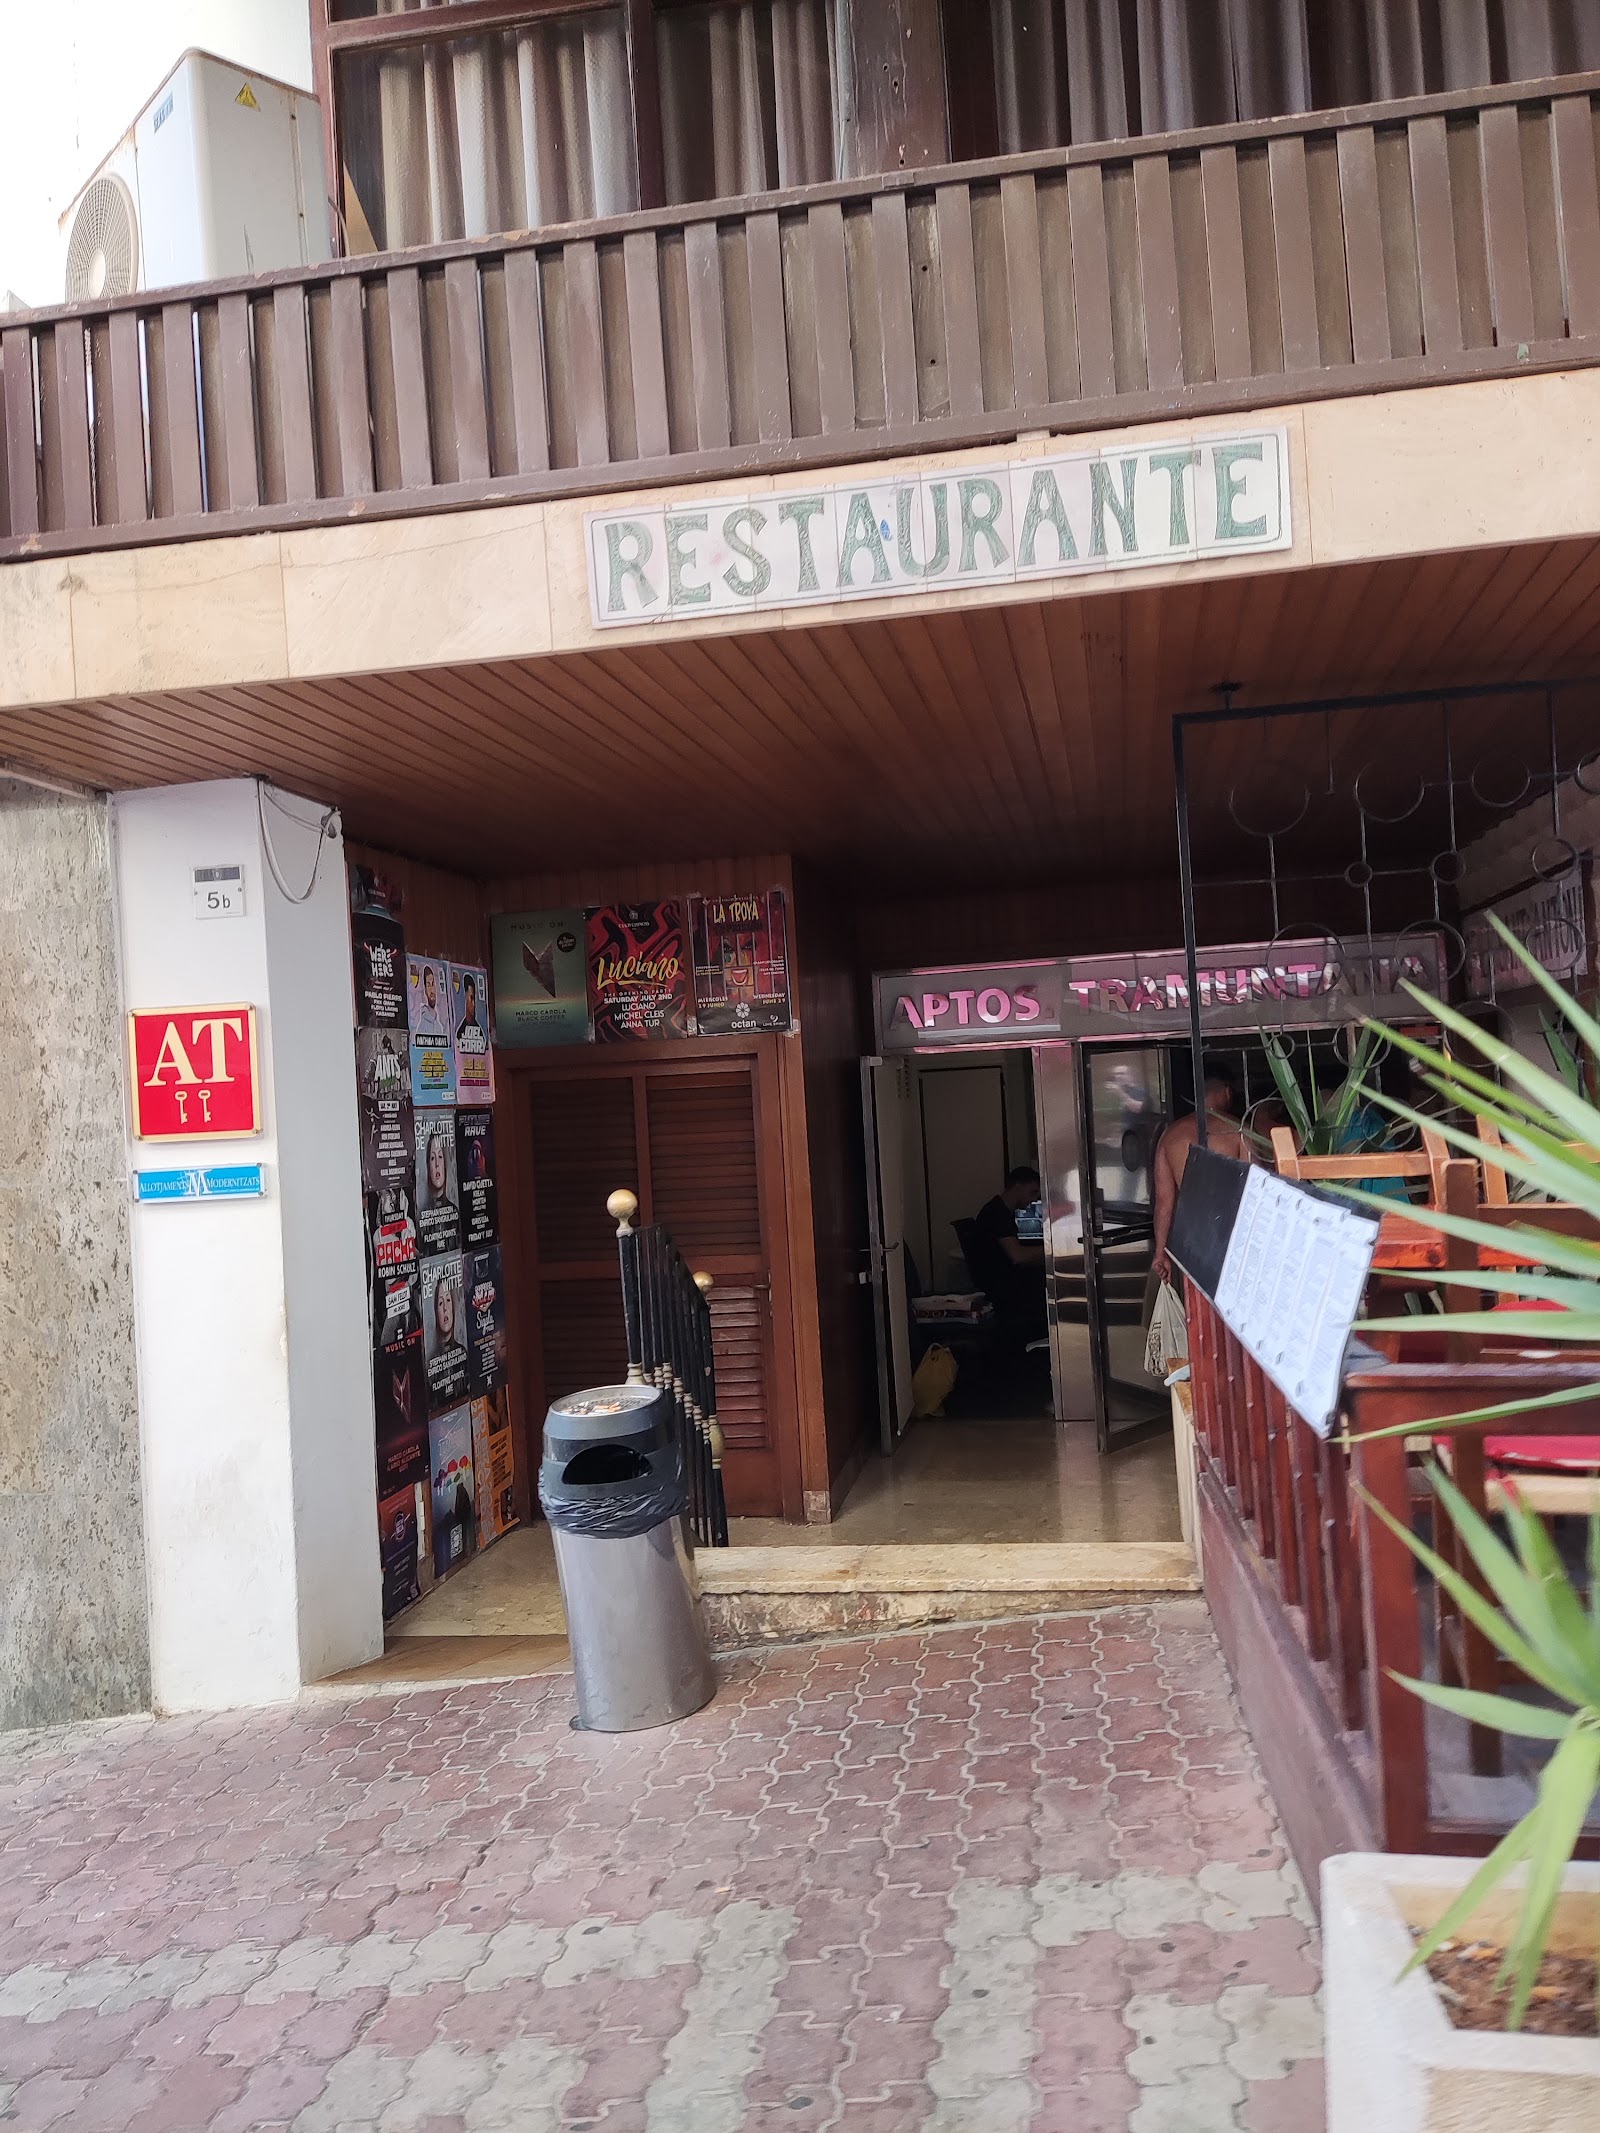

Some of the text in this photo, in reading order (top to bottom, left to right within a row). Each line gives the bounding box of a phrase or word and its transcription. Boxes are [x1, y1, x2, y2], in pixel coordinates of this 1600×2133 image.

[604, 442, 1269, 612] RESTAURANTE
[207, 891, 231, 909] 5b
[713, 901, 759, 923] LA TROYA
[549, 921, 564, 929] ON
[597, 951, 679, 990] Luciano
[604, 993, 673, 1004] SATURDAY JULY 2ND
[621, 1002, 656, 1011] LUCIANO
[614, 1010, 665, 1021] MICHEL CLEIS
[620, 1020, 660, 1029] ANNA TUR
[731, 1019, 756, 1028] octan
[461, 1026, 482, 1039] JOEL
[144, 1017, 244, 1087] AT
[374, 1054, 401, 1081] ANTS
[414, 1120, 454, 1136] CHARLOTTE
[464, 1125, 486, 1137] RAVE
[416, 1134, 455, 1150] DE WITTE
[463, 1178, 493, 1191] DAVID GUETTA
[384, 1212, 404, 1222] THURSDAY
[421, 1208, 439, 1219] STEPHAN
[419, 1217, 434, 1228] ENRICO
[424, 1228, 457, 1243] FLOATING POINTS
[378, 1262, 416, 1278] ROBIN SCHULZ
[423, 1260, 462, 1284] CHARLOTTE
[423, 1274, 463, 1300] DE WITTE
[385, 1337, 416, 1354] MUSIC ON
[429, 1354, 448, 1368] STEPHAN
[428, 1364, 443, 1377] ENRICO
[432, 1370, 465, 1392] FLOATING POINTS
